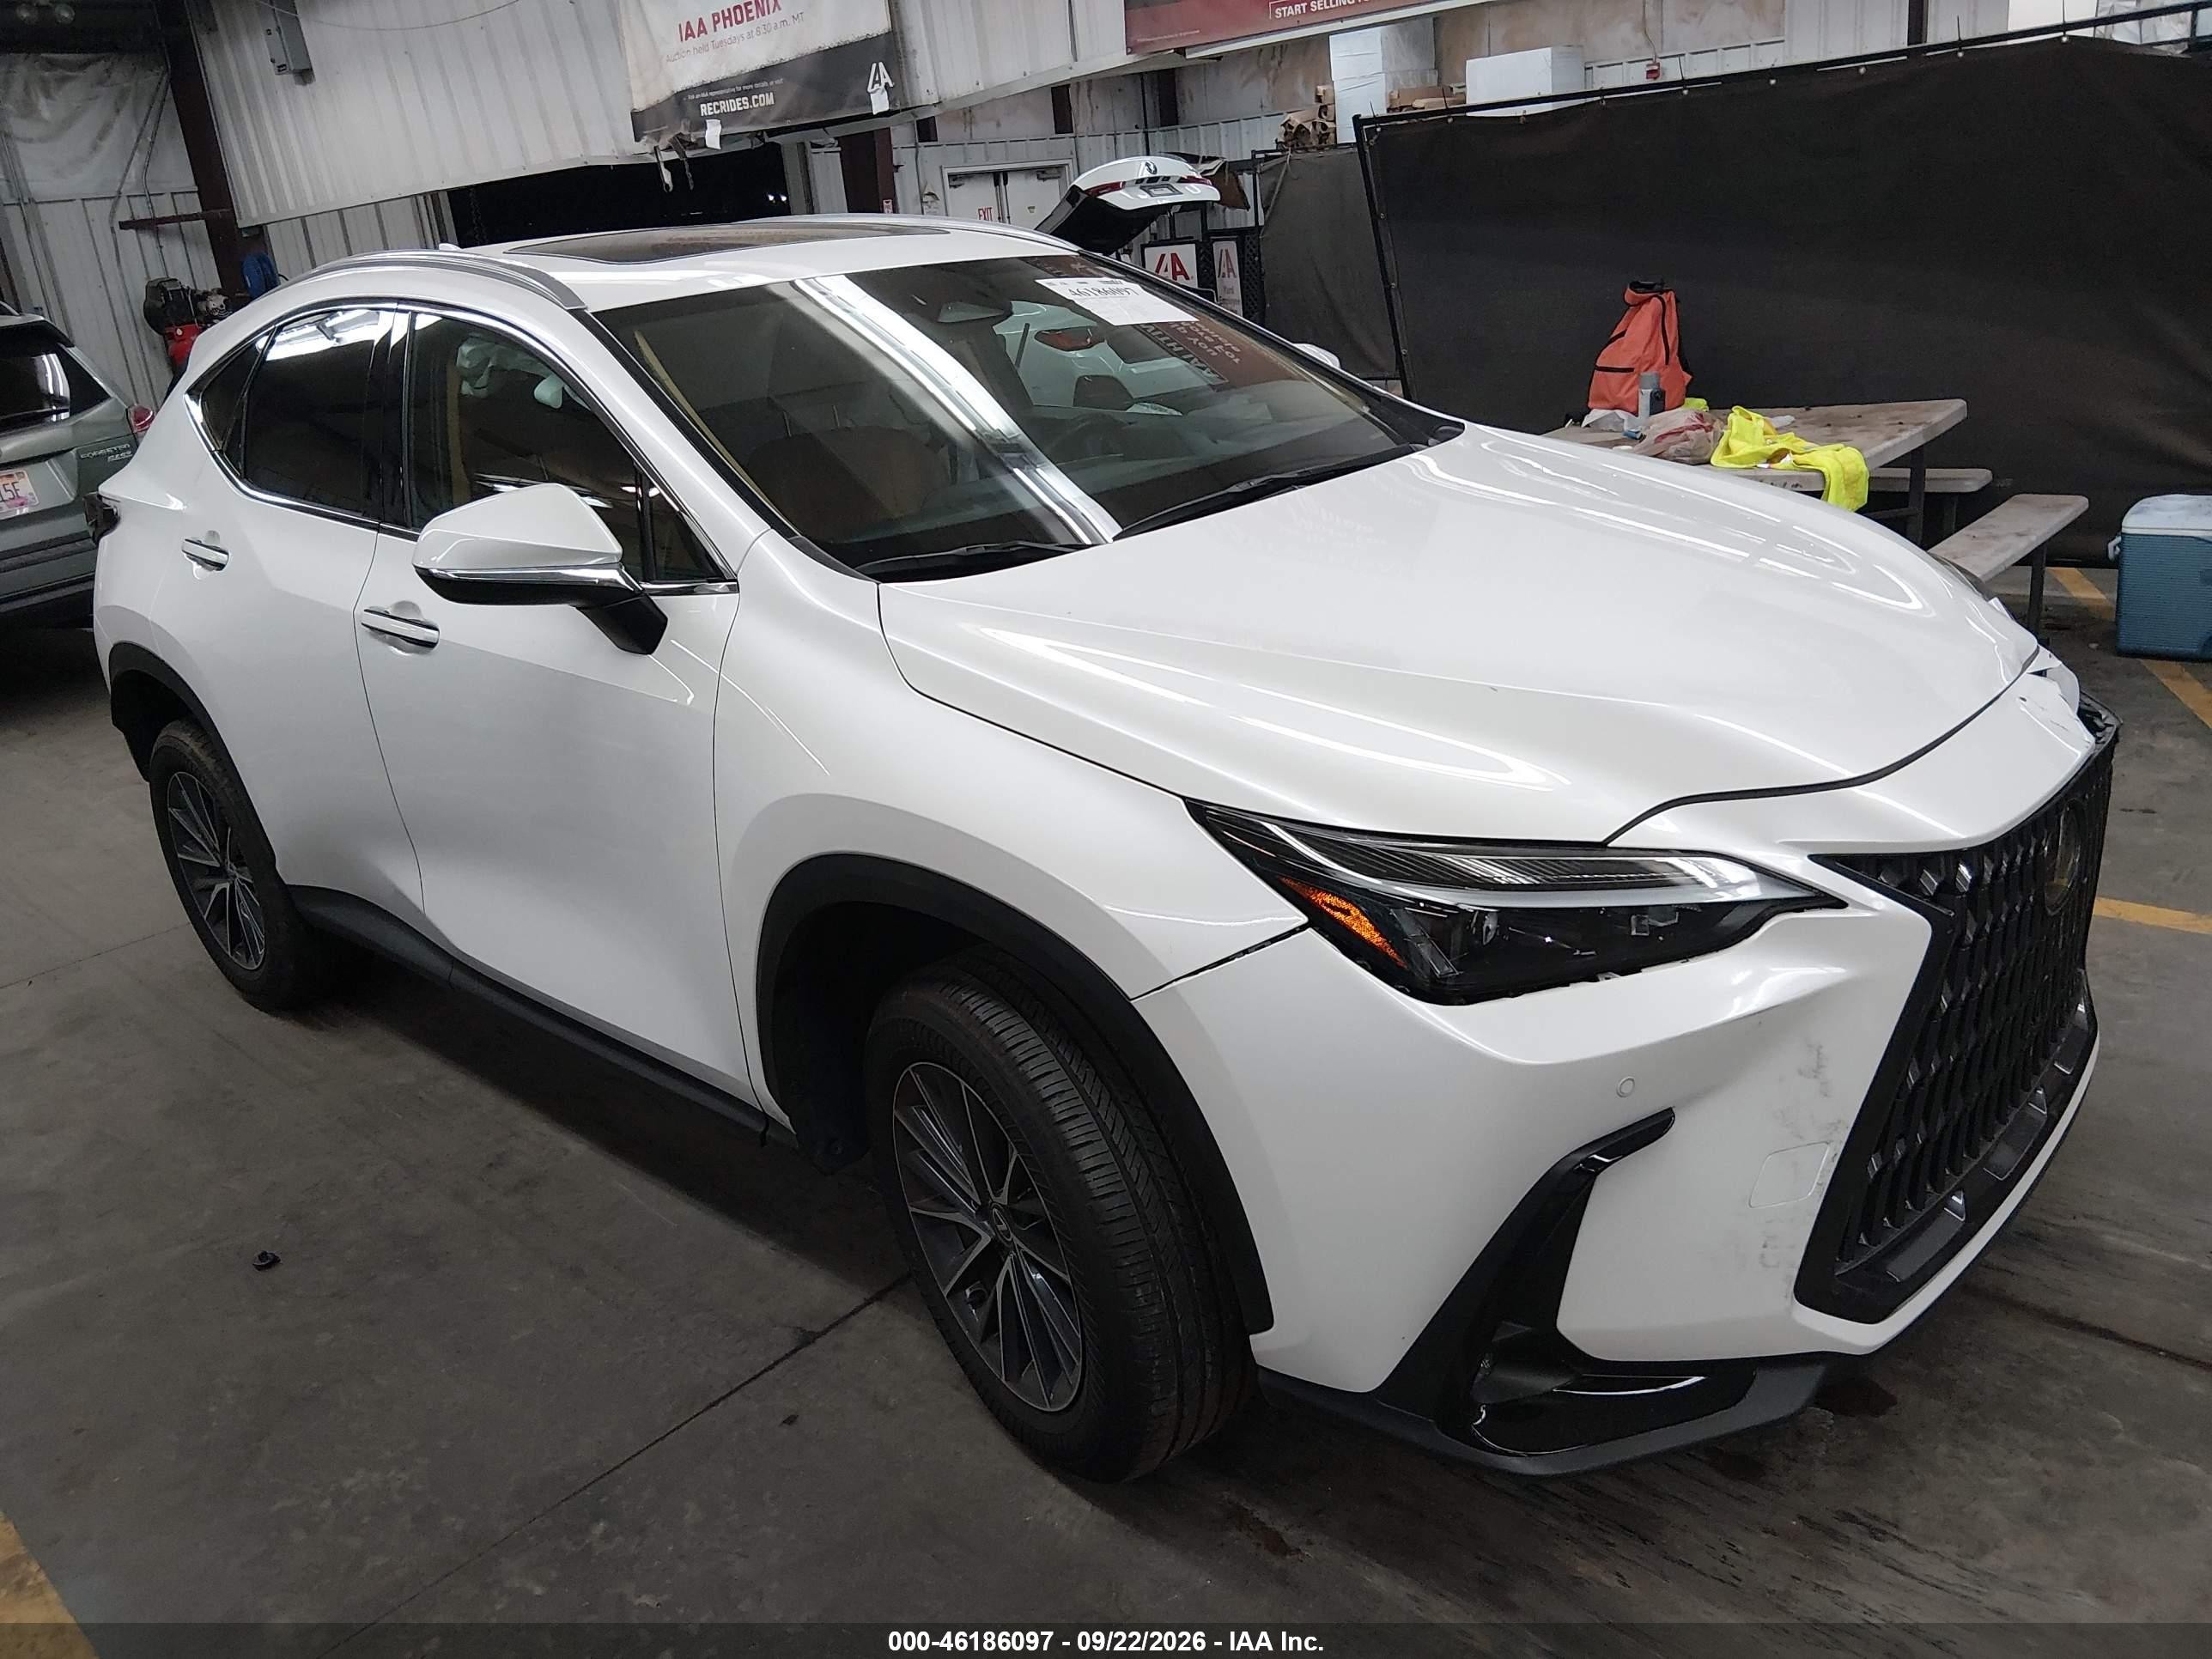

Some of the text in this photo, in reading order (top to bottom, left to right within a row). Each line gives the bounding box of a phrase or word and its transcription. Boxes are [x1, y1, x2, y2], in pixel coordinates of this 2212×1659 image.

[678, 0, 782, 42] IAA PHOENIX
[1274, 3, 1308, 19] START
[693, 42, 709, 56] held
[711, 33, 745, 49] Tuesdays
[746, 31, 755, 40] at
[792, 12, 805, 25] MT
[700, 92, 775, 116] RECRIDES.COM
[978, 207, 993, 222] EXIT
